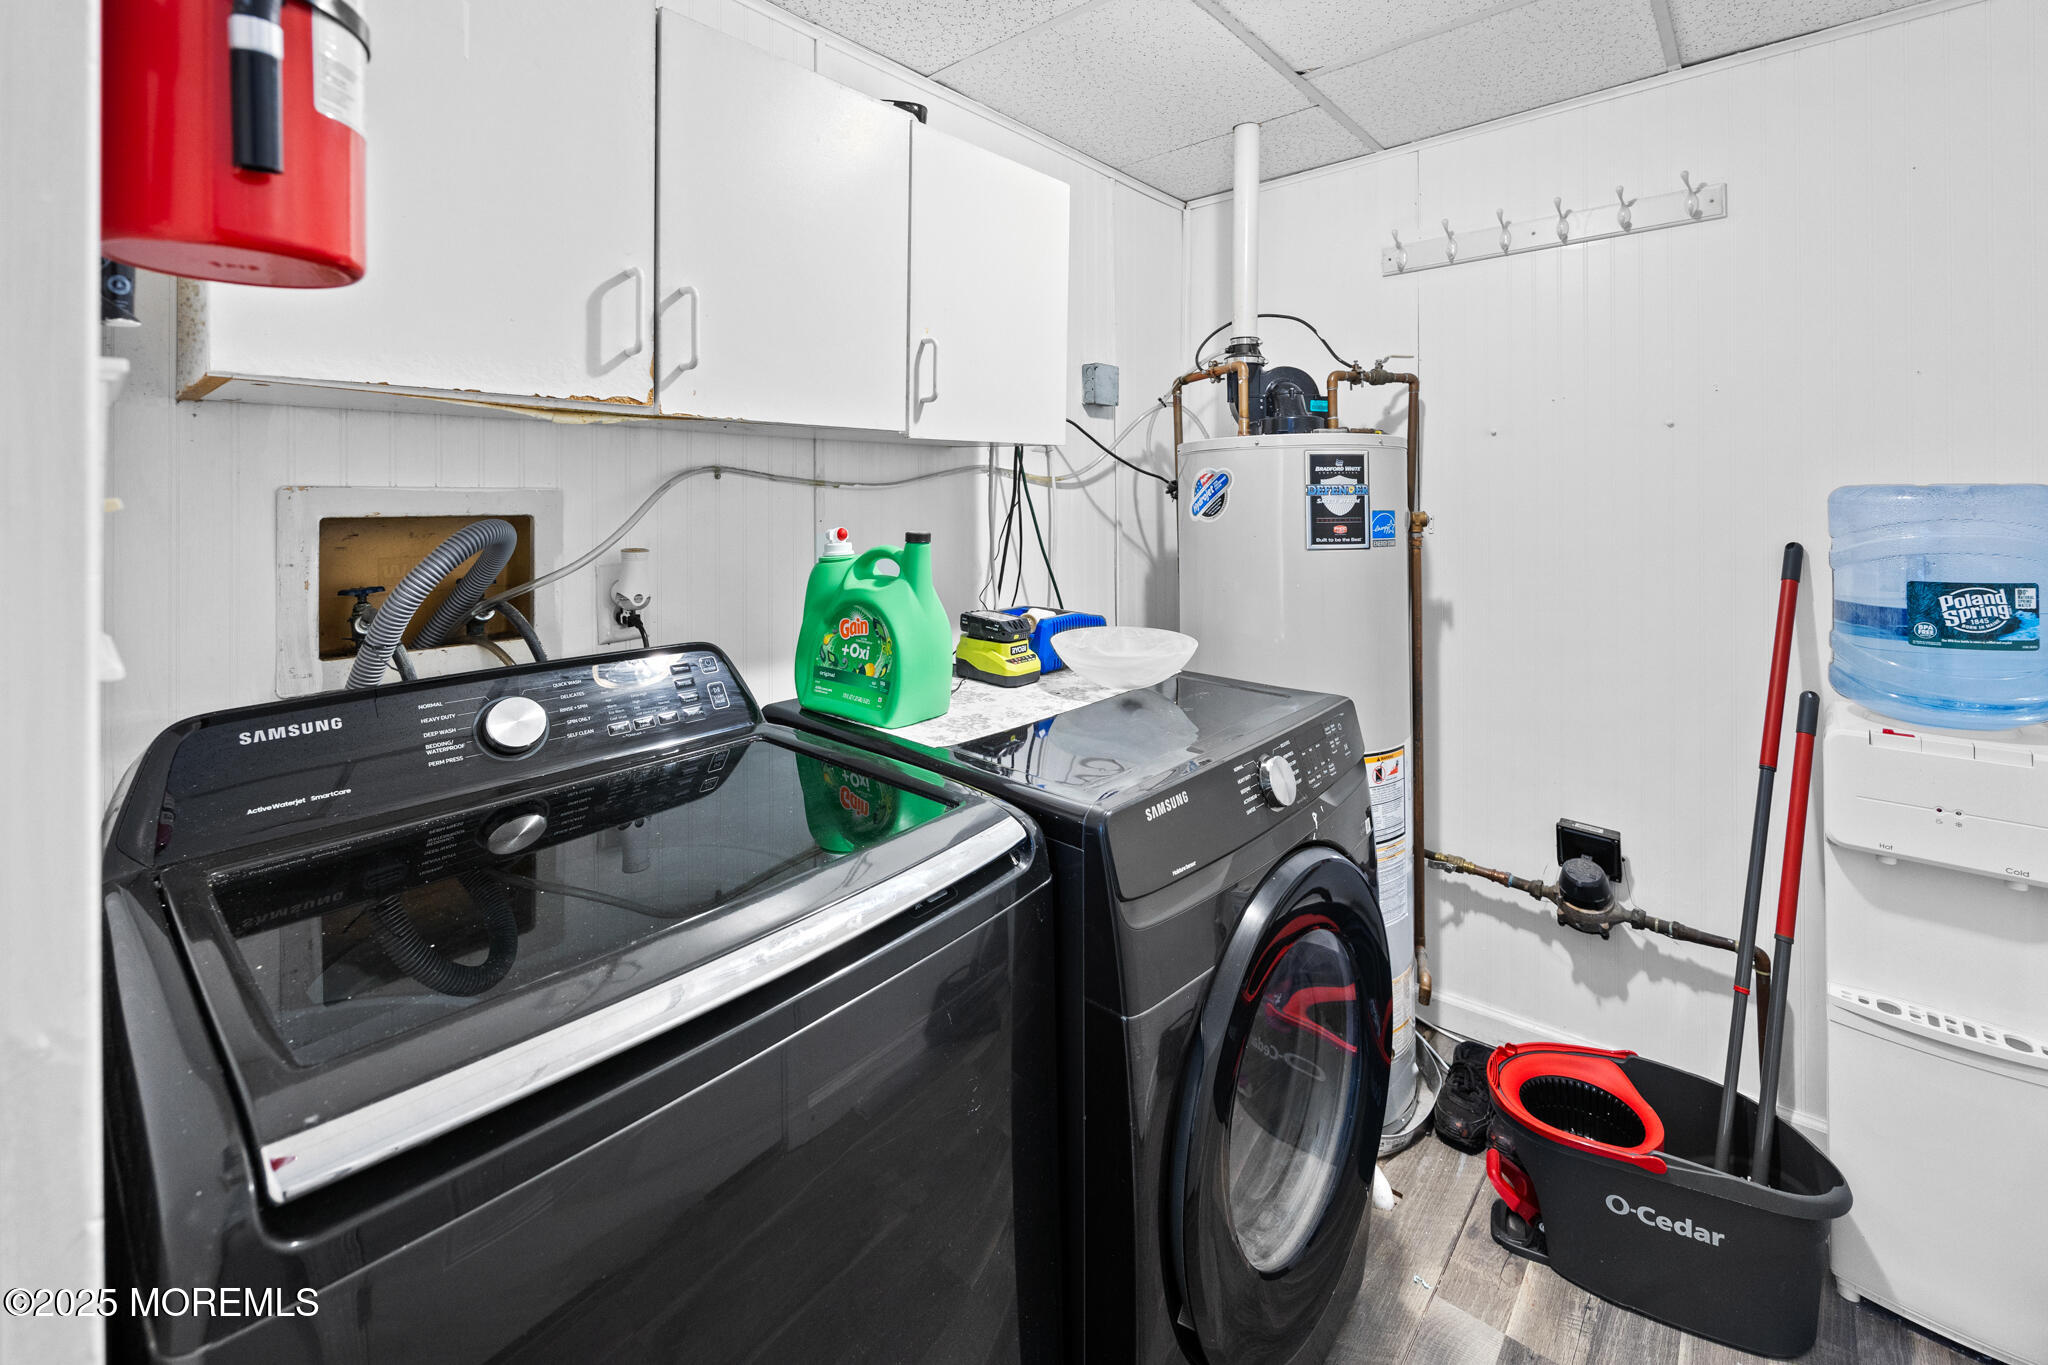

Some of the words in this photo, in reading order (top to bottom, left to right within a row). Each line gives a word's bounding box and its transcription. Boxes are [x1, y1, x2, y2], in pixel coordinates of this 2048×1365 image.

[1307, 485, 1368, 496] DEFENDER
[1938, 589, 2008, 611] Poland
[1941, 604, 2010, 627] Spring
[839, 617, 869, 639] Gain
[841, 643, 870, 660] +Oxi
[1011, 645, 1027, 655] RYOBI
[560, 691, 585, 699] DELICATES
[418, 702, 443, 710] NORMAL
[420, 716, 440, 724] HEAVY
[440, 713, 456, 721] DUTY
[239, 717, 343, 745] SAMSUNG
[423, 730, 439, 738] DEEP
[439, 727, 457, 735] WASH
[578, 728, 595, 736] CLEAN
[426, 743, 465, 755] WATERPROOF
[428, 759, 445, 768] PERM
[445, 755, 464, 764] PRESS
[1145, 791, 1189, 821] SAMSUNG
[1879, 842, 1894, 851] Hot
[2005, 867, 2030, 878] Cold
[1605, 1193, 1726, 1247] O-Cedar
